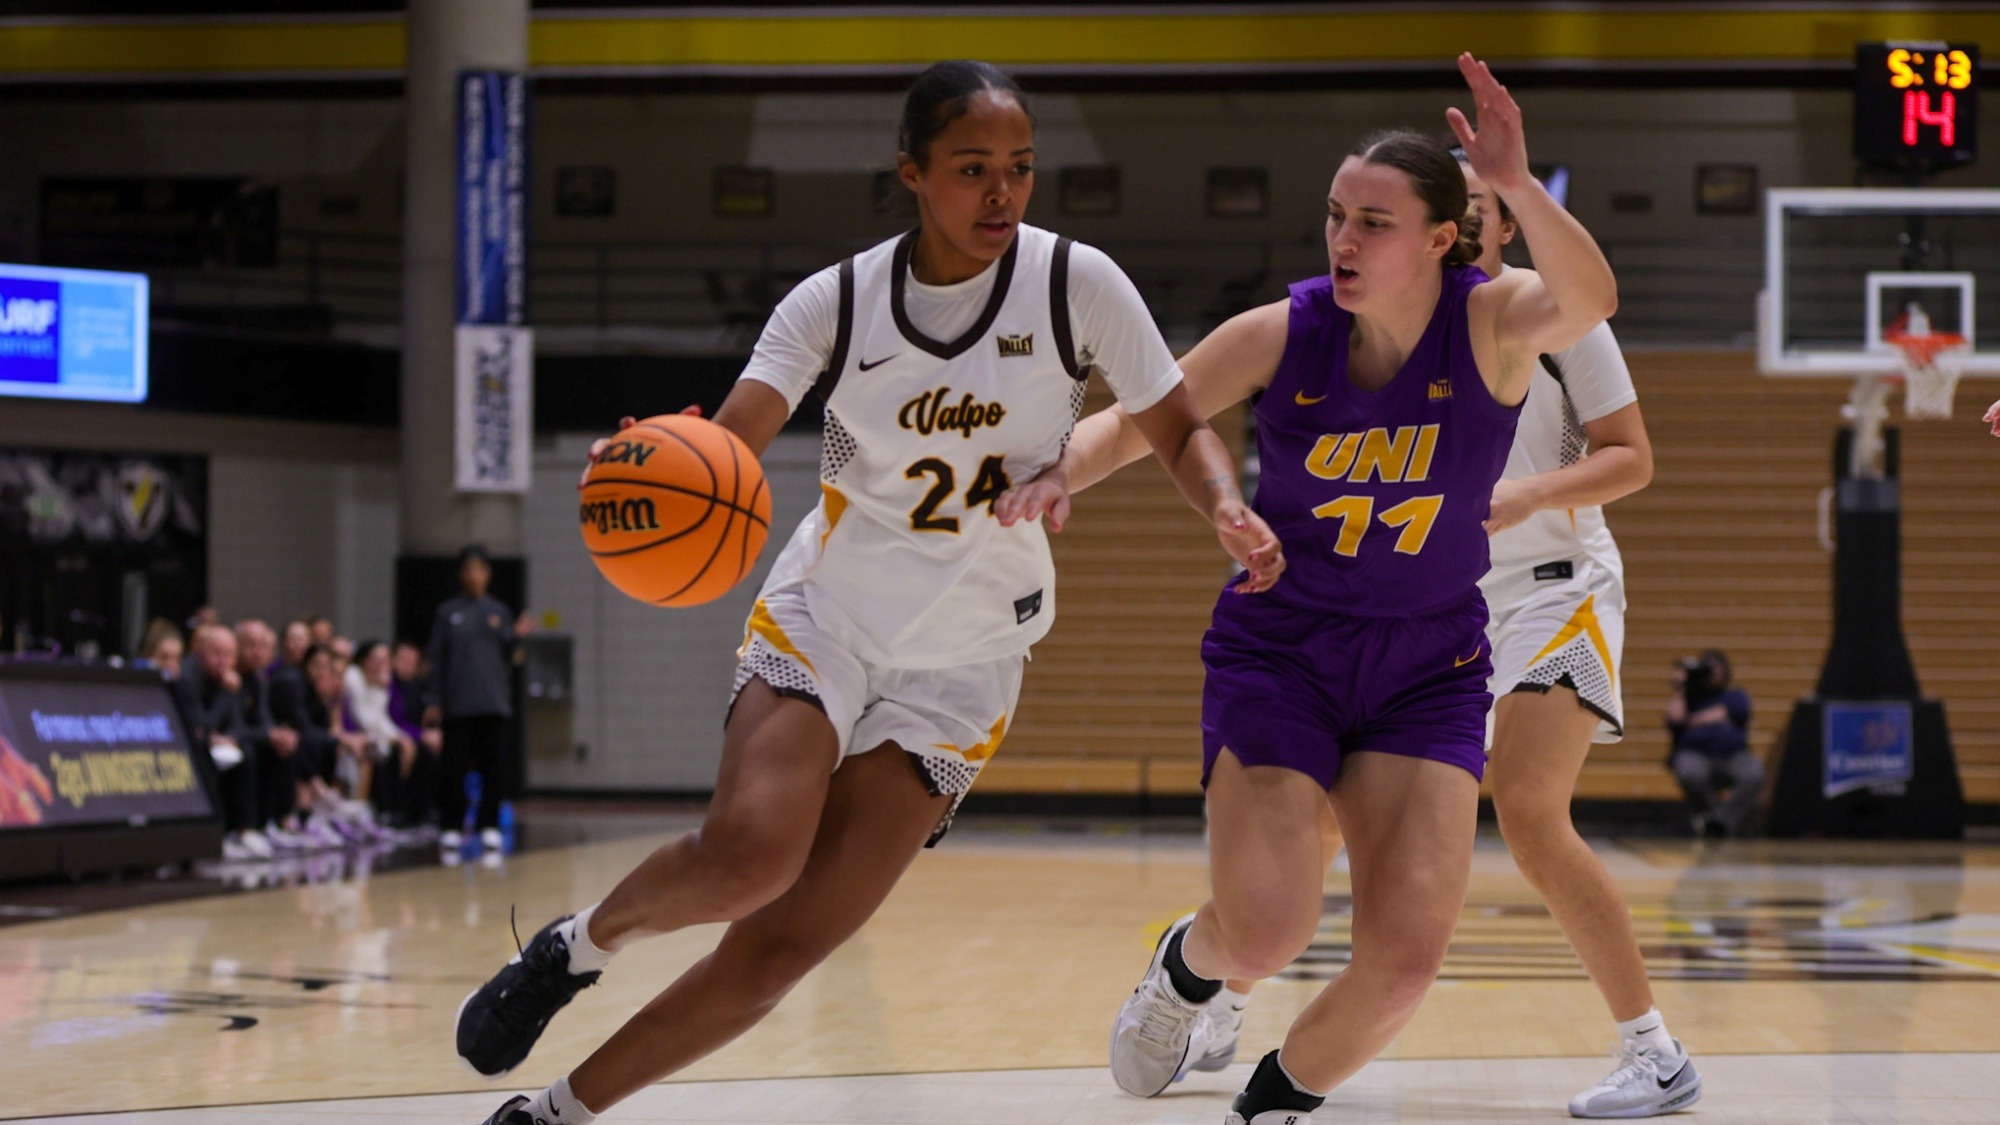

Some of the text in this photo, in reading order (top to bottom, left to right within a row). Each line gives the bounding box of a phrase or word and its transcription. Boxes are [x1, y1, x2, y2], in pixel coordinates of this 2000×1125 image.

[1887, 48, 1971, 89] 5:13
[1903, 90, 1955, 147] 14
[898, 386, 1006, 439] Valpo
[1304, 423, 1441, 483] UNI
[904, 453, 1013, 535] 24
[1311, 493, 1445, 558] 11
